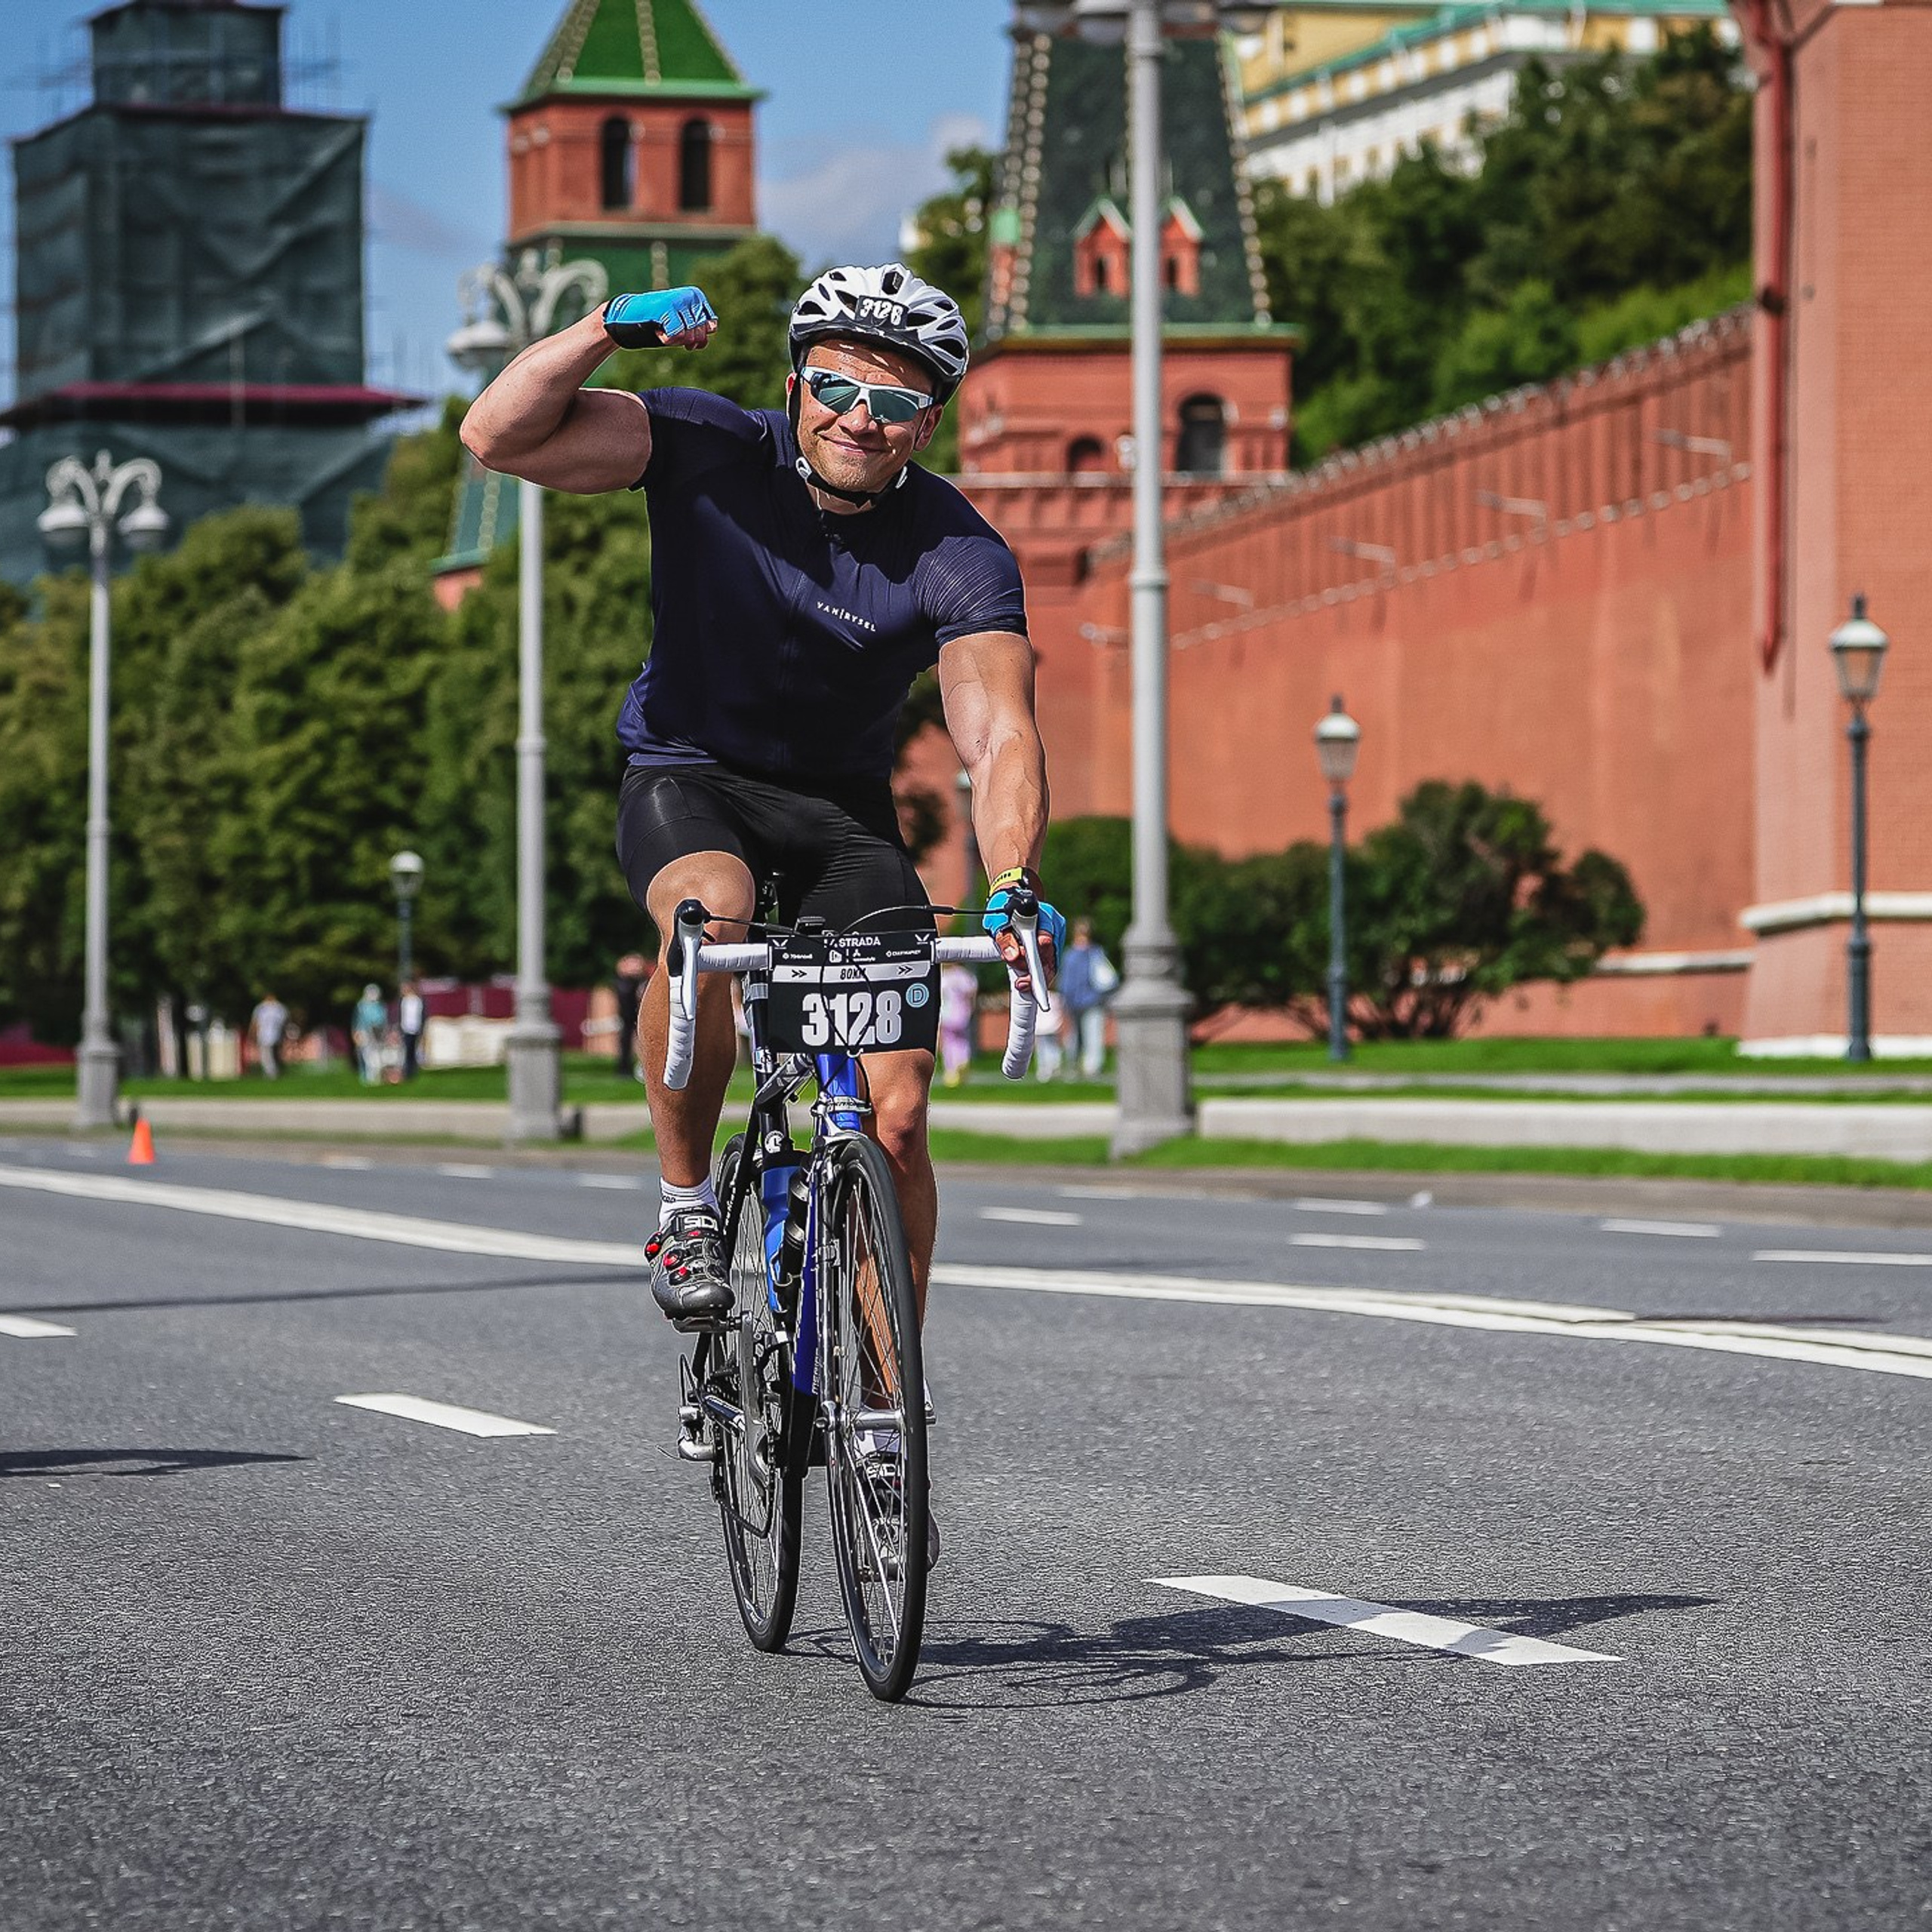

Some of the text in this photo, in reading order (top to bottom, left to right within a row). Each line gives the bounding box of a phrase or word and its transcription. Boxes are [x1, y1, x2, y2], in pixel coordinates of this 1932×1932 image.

[860, 298, 903, 326] 3128
[838, 936, 881, 948] STRADA
[801, 990, 902, 1047] 3128
